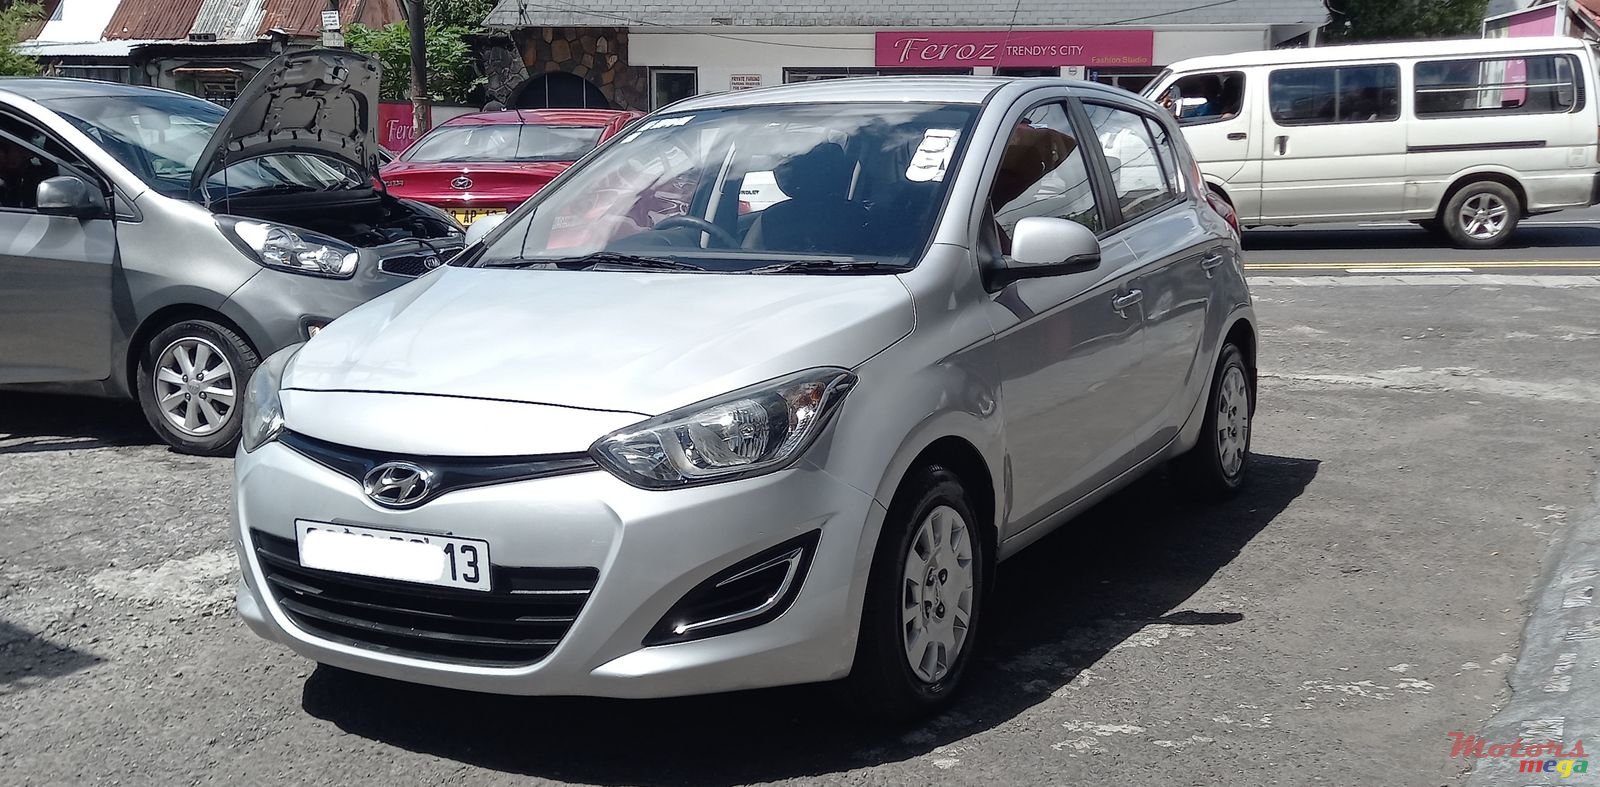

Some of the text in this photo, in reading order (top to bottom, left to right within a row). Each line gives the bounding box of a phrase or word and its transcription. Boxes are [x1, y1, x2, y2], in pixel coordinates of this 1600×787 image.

[894, 38, 998, 63] Feroz
[1006, 45, 1084, 56] TRENDY'S CITY
[1091, 56, 1147, 64] Fashion Studio
[386, 119, 416, 142] Fero
[464, 210, 476, 223] AP
[443, 543, 480, 584] 13
